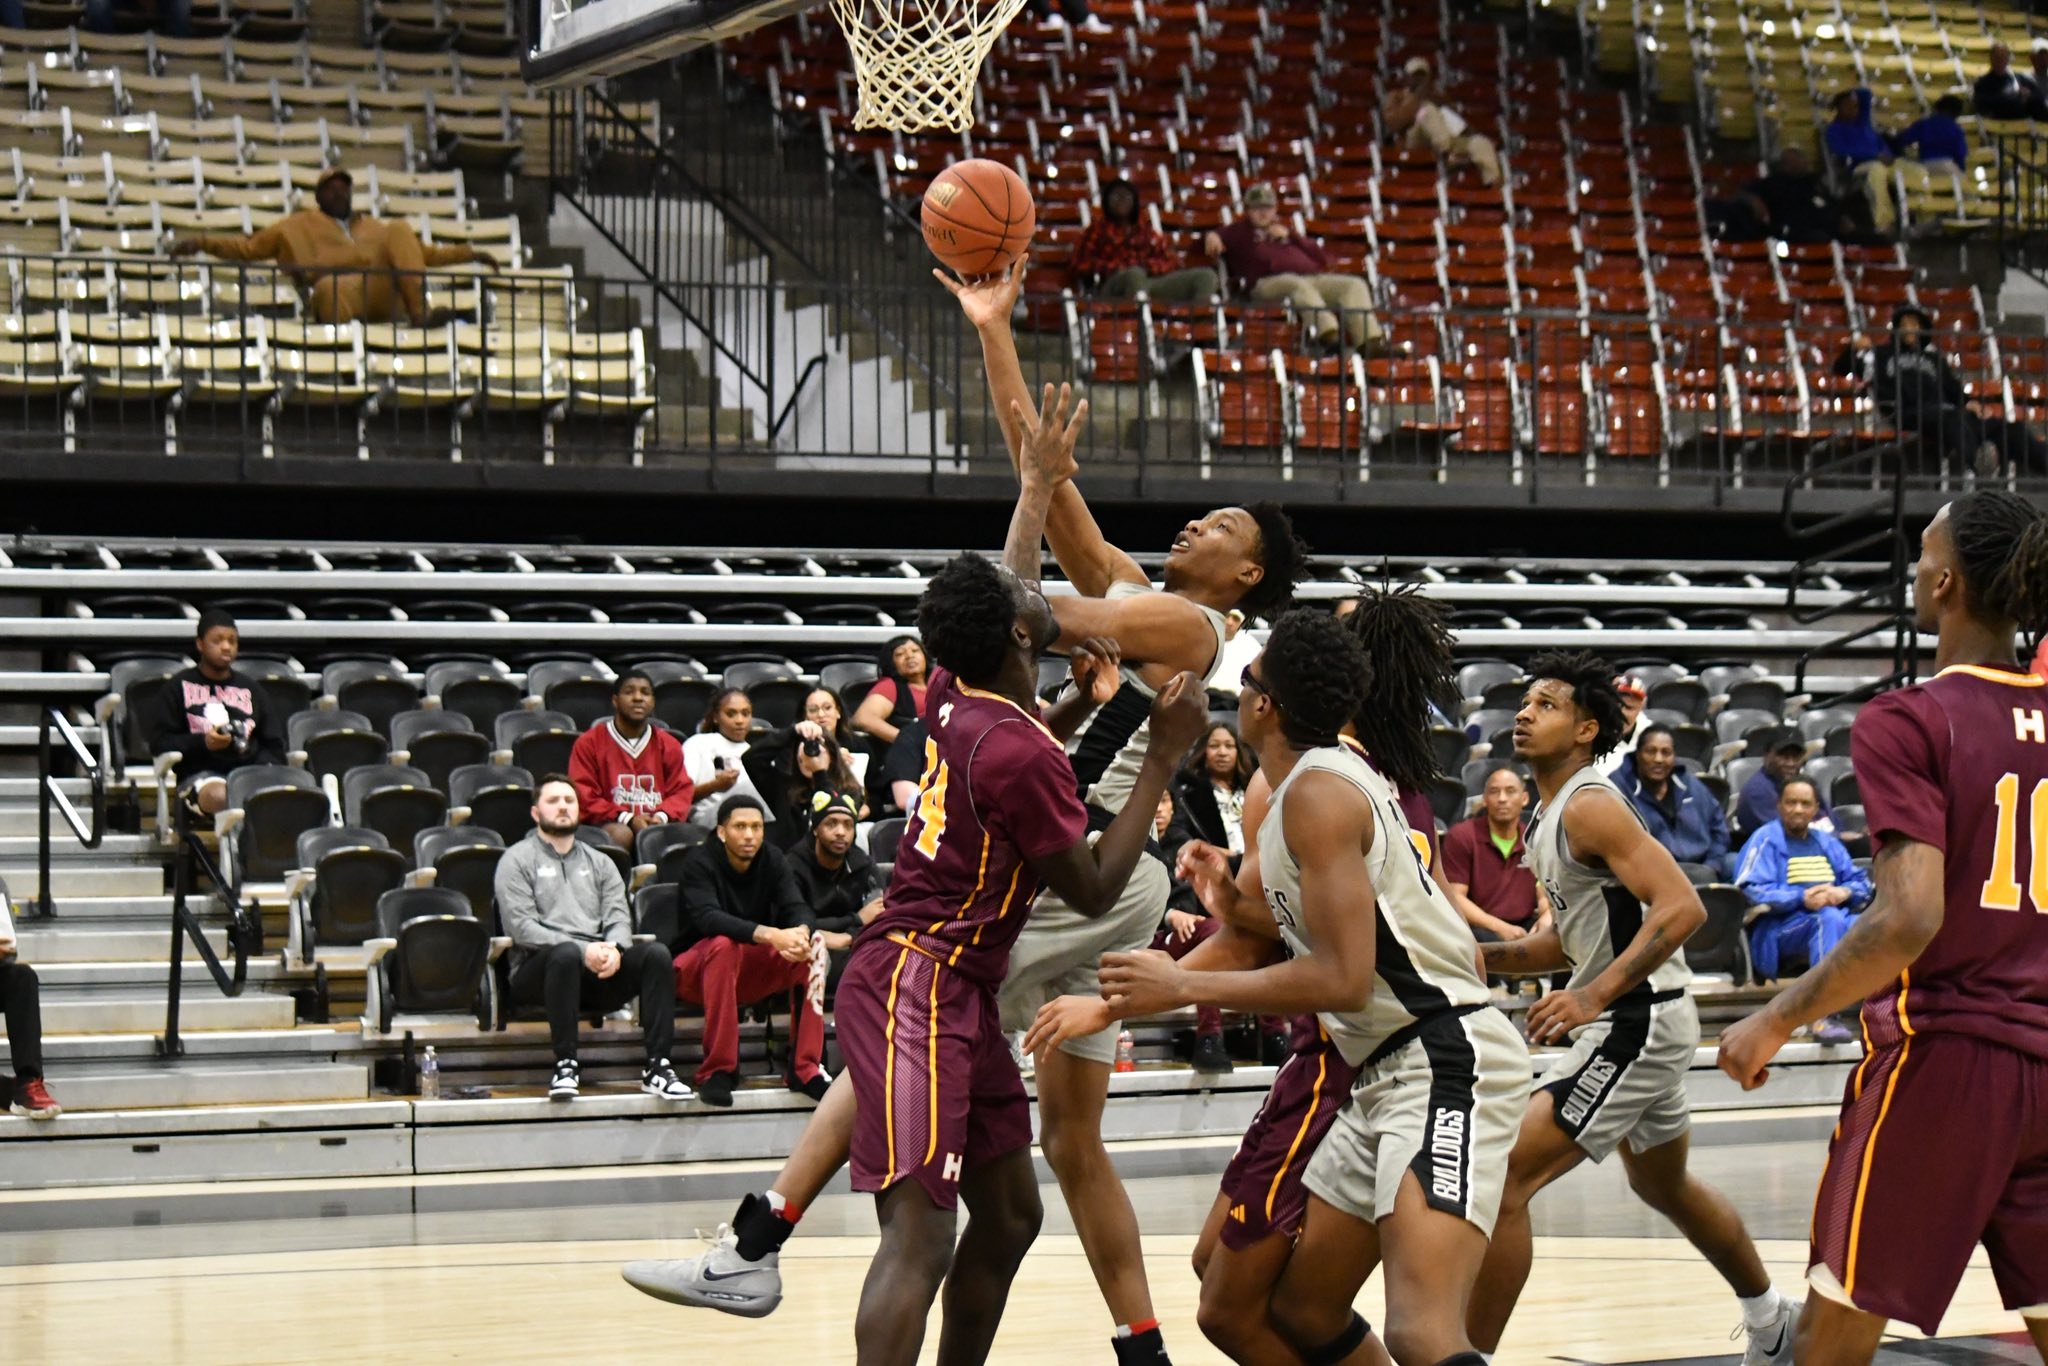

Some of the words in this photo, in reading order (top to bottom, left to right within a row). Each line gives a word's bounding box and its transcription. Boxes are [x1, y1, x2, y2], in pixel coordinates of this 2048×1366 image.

[2013, 707, 2046, 743] H
[1561, 1054, 1618, 1127] BULLDOGS
[942, 1151, 963, 1182] H
[1431, 1107, 1465, 1203] BULLDOGS
